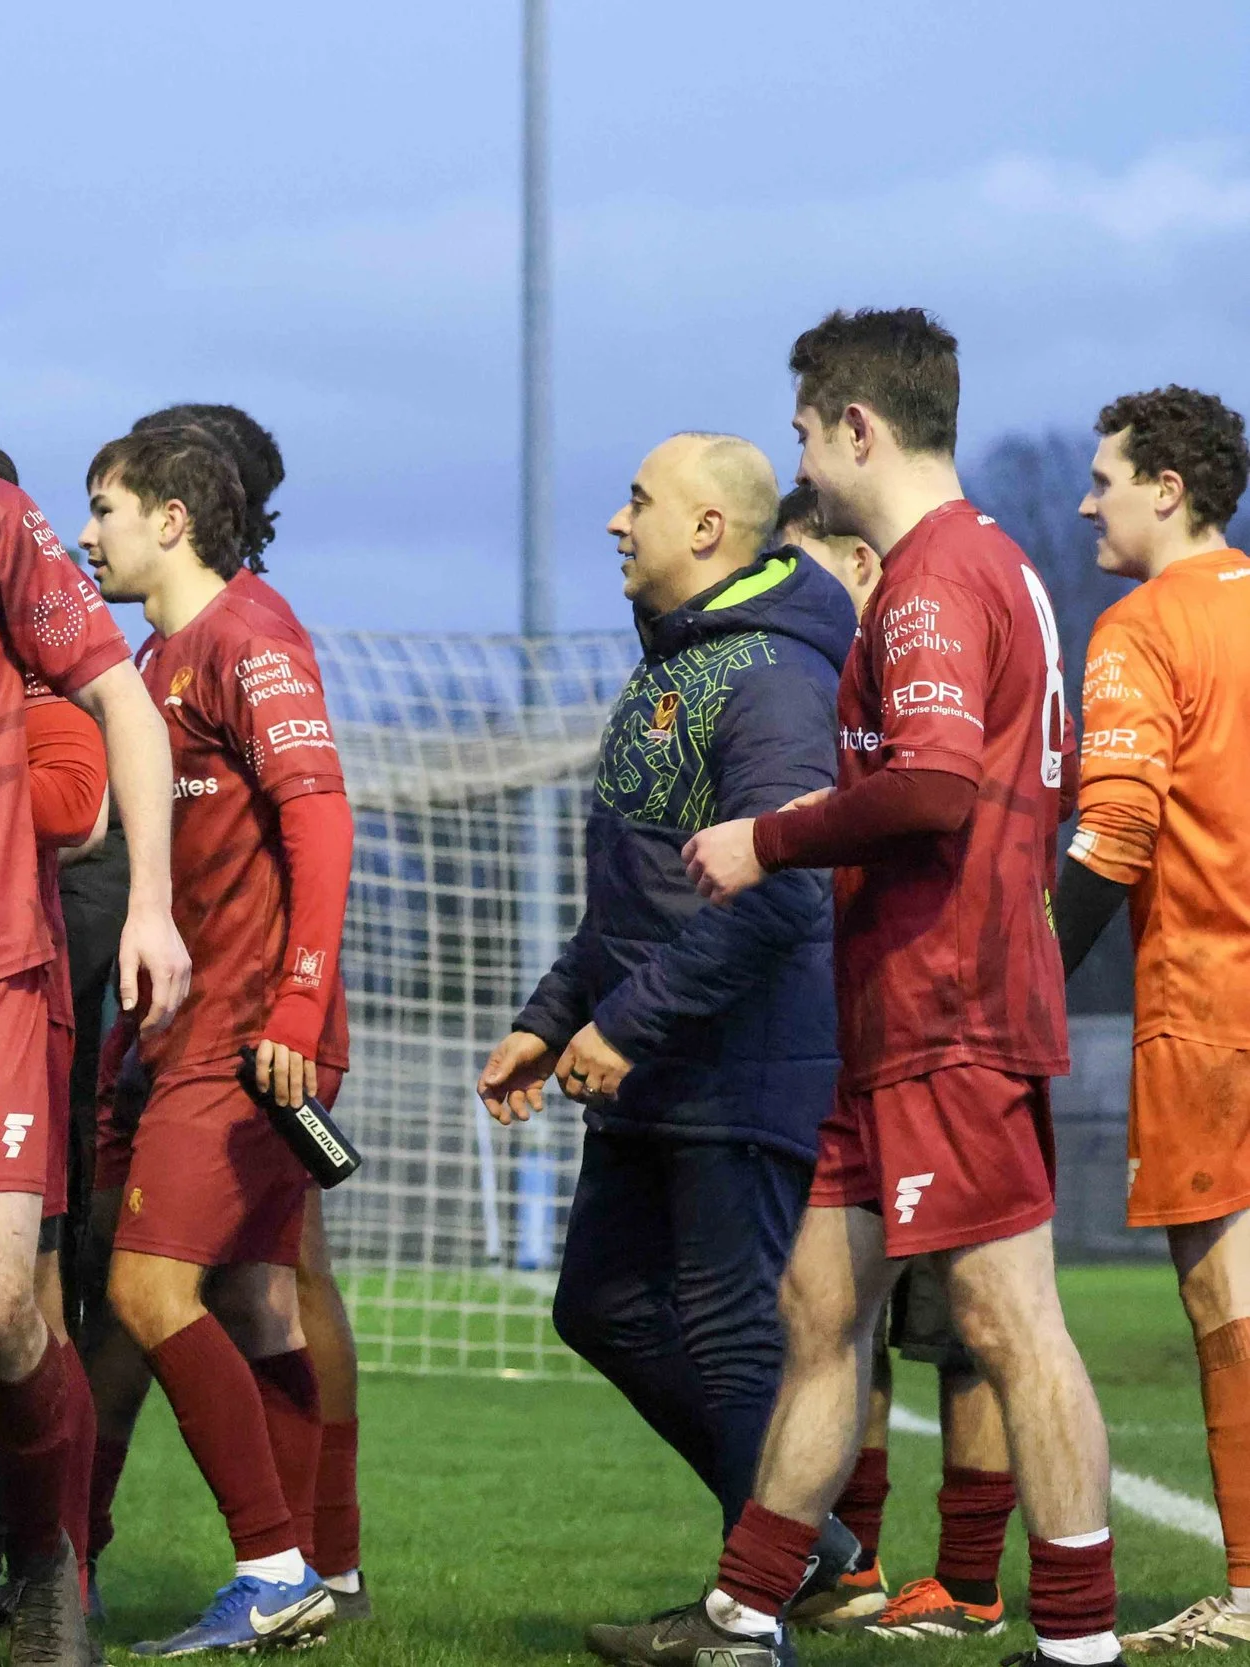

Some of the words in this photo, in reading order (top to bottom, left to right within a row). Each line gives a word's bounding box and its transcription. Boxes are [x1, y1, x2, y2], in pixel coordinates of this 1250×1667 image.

[234, 649, 291, 678] Charles
[886, 631, 962, 666] peechlys
[240, 663, 292, 693] Russell
[893, 681, 963, 711] EDR
[896, 705, 930, 717] erprise
[931, 705, 963, 718] Digital
[267, 719, 330, 745] EDR
[300, 1110, 344, 1162] ZILAND
